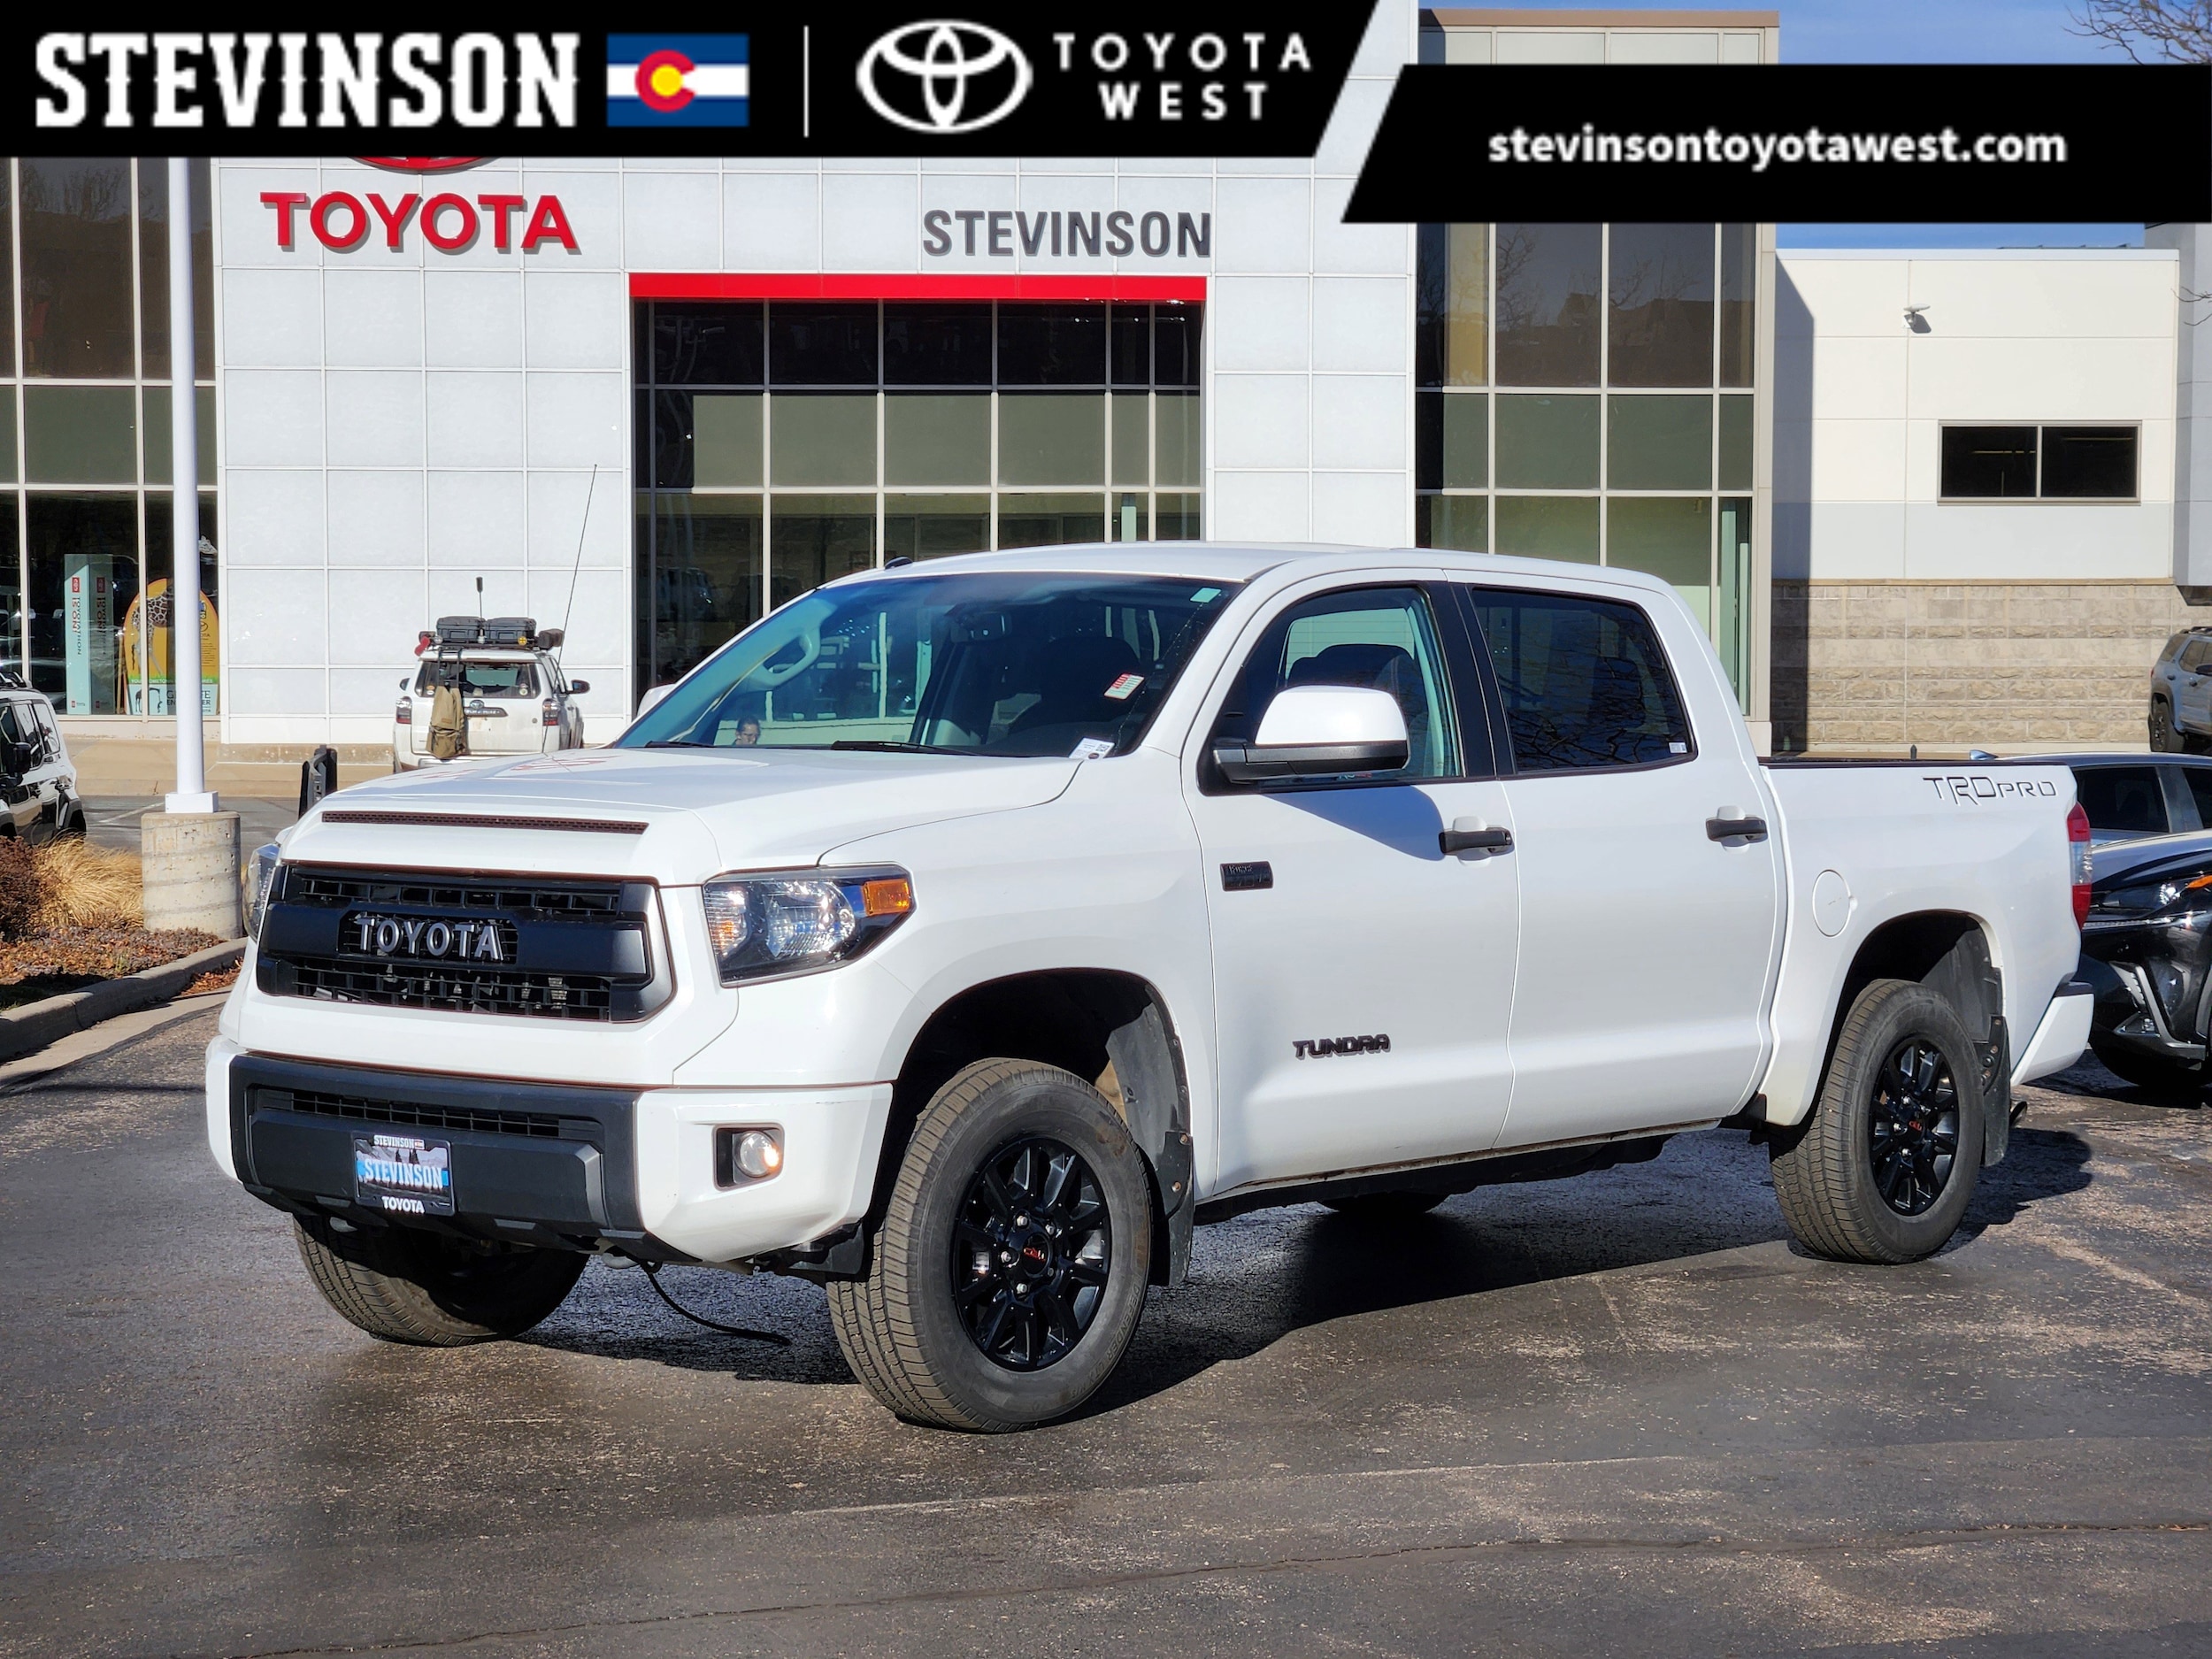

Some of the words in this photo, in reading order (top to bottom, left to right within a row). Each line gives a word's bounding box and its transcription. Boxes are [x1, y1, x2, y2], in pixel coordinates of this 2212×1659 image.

[261, 192, 576, 249] TOYOTA
[924, 211, 1210, 257] STEVINSON
[1922, 775, 1997, 806] TRD
[1997, 781, 2057, 799] PRO
[357, 917, 503, 962] TOYOTA
[1292, 1033, 1391, 1060] TUNDRA
[373, 1134, 415, 1149] STEVINSON
[364, 1157, 443, 1190] STEVINSON
[381, 1195, 426, 1214] TOYOTA
